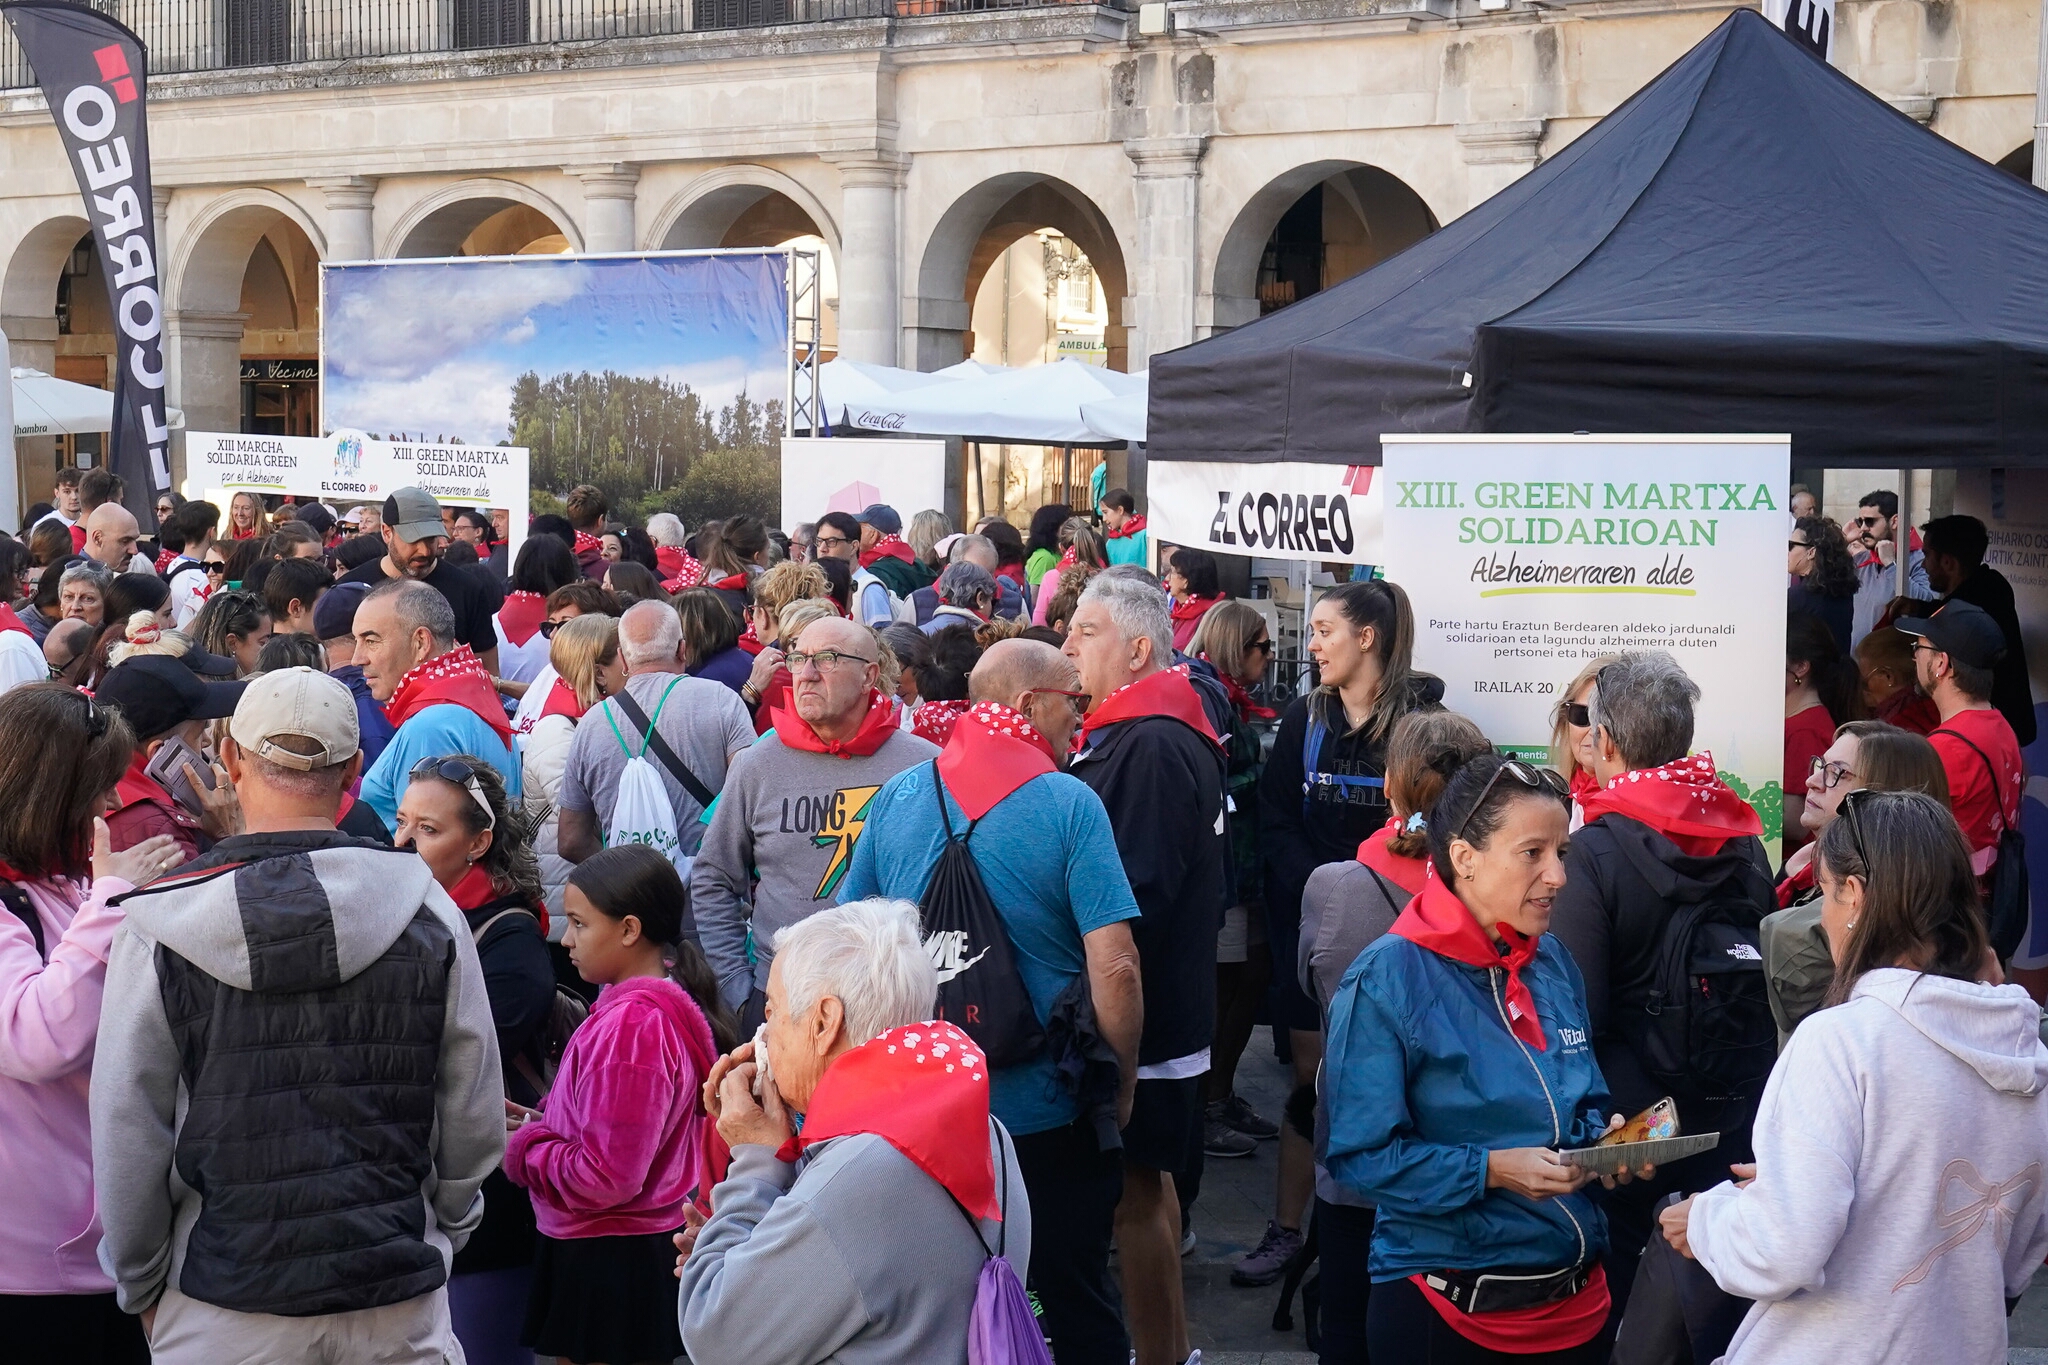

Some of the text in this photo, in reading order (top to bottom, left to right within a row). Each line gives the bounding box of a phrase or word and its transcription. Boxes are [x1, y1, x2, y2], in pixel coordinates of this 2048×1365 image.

[1059, 341, 1105, 350] AMBULA
[240, 361, 318, 379] La Vecina
[14, 423, 48, 435] lhambra
[217, 439, 284, 454] XIII MARCHA
[207, 452, 298, 468] SOLIDARIA GREEN
[393, 447, 510, 465] XIII. GREEN MARTXA
[221, 468, 285, 484] por el Alzheimer
[416, 462, 487, 478] SOLIDARIOA
[321, 481, 331, 491] EL
[332, 482, 366, 493] CORREO
[474, 482, 490, 498] alde
[1396, 481, 1777, 511] XIII. GREEN MARTXA
[1209, 491, 1354, 556] EL CORREO
[1458, 516, 1719, 546] SOLIDARIOAN
[1987, 530, 2032, 549] BIHARKO
[1470, 550, 1695, 585] Alzheimerraren alde
[1984, 549, 2048, 569] URTIK ZAINT
[1429, 618, 1736, 636] Parte hartu Eraztun Berdearen aldeko jardunaldi
[1446, 633, 1718, 648] solidarioan eta lagundu alzheimerra duten
[1494, 647, 1553, 659] pertsonei
[1557, 649, 1577, 659] eta
[1474, 680, 1534, 694] IRAILAK
[1537, 682, 1554, 694] 20
[1505, 751, 1548, 760] mentia
[780, 792, 846, 833] LONG
[922, 930, 969, 969] NIKE
[939, 1004, 981, 1024] IR
[1558, 1027, 1587, 1046] Vital
